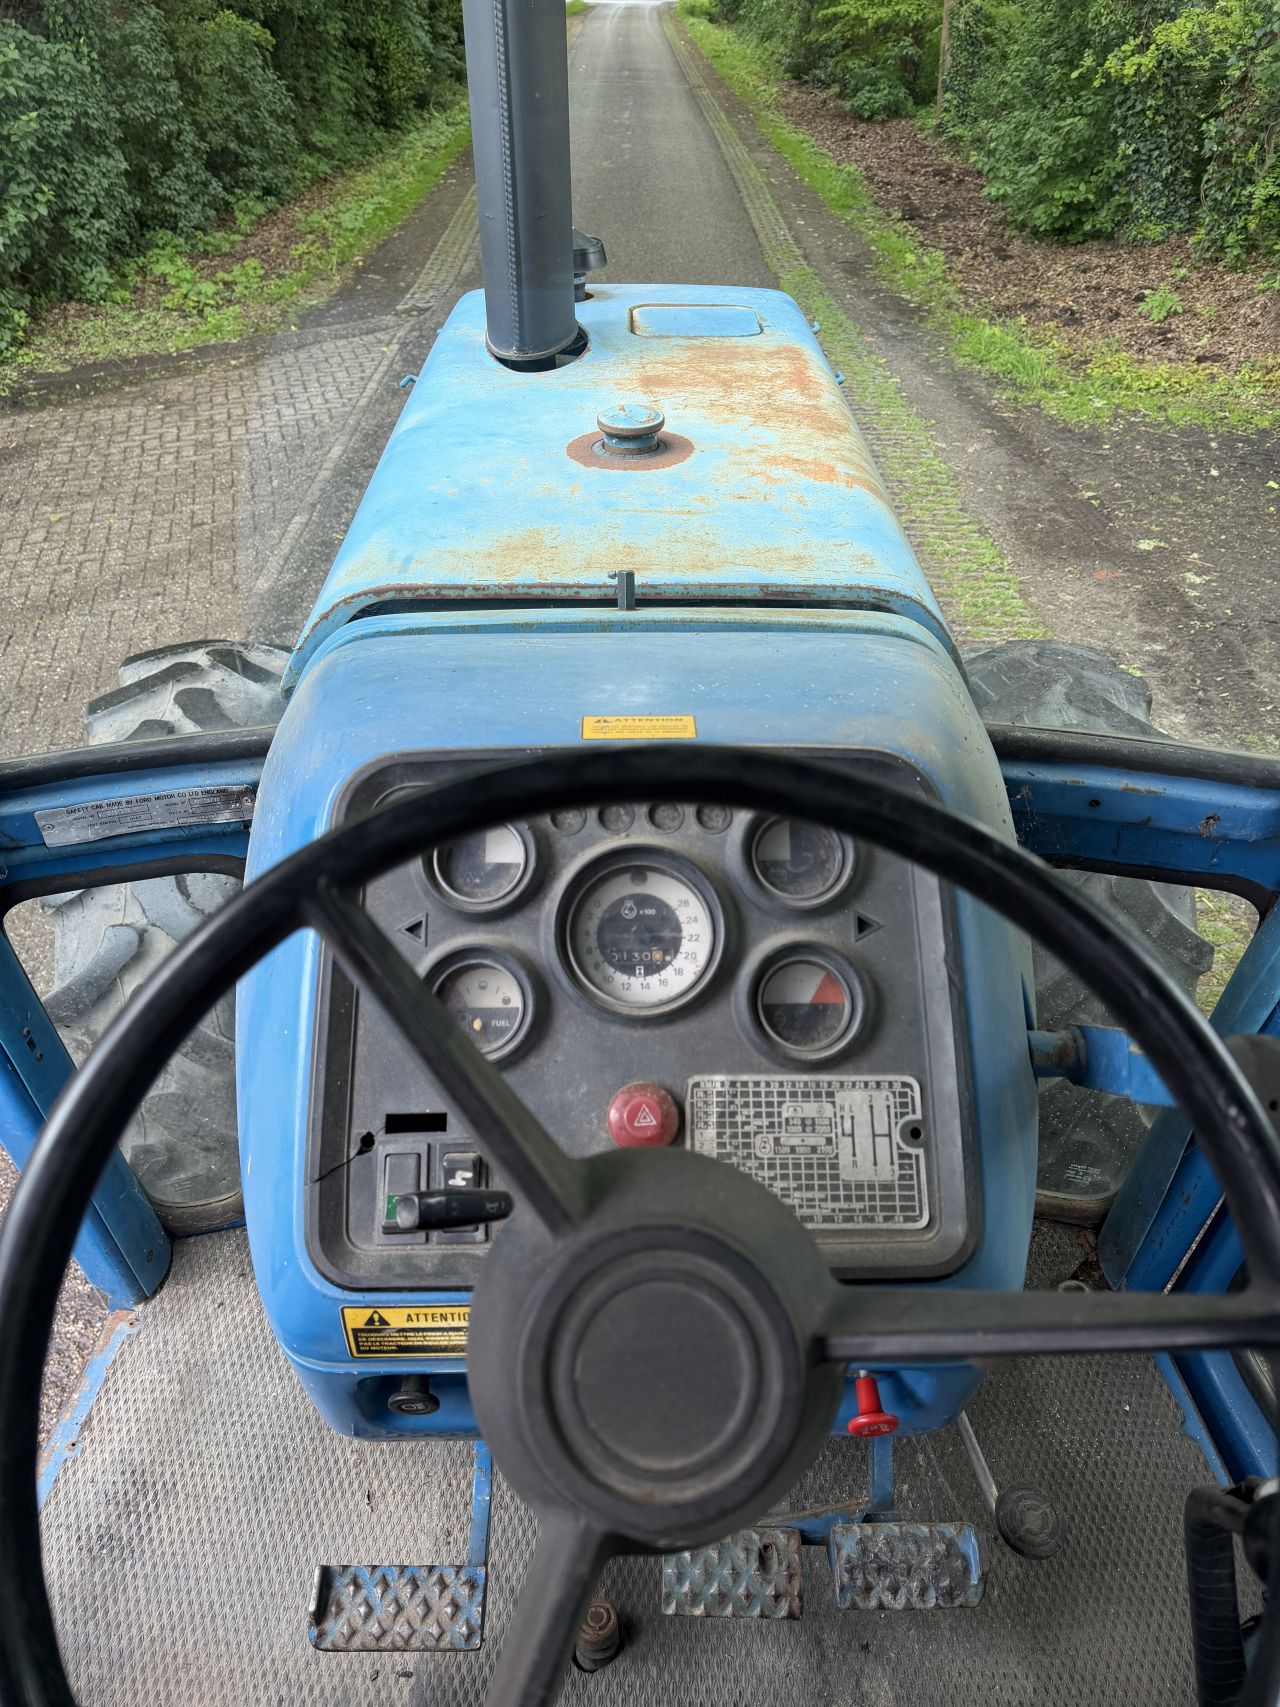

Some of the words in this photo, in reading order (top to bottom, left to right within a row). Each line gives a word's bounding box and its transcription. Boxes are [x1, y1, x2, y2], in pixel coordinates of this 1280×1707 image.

[65, 806, 89, 815] SAFETY
[91, 803, 104, 811] CAB
[106, 800, 123, 808] MADE
[154, 793, 175, 801] MOTOR
[201, 788, 229, 796] ENGLAND
[677, 899, 690, 908] 26
[686, 916, 699, 925] 24
[687, 934, 701, 943] 22
[684, 951, 697, 961] 20
[673, 967, 684, 977] 18
[603, 975, 614, 984] 10
[658, 978, 669, 988] 16
[621, 983, 632, 992] 12
[640, 983, 651, 992] 14
[491, 1019, 511, 1028] FUEL
[852, 1159, 858, 1169] R
[814, 1215, 823, 1224] 10
[835, 1215, 843, 1224] 12
[855, 1215, 863, 1224] 14
[875, 1215, 884, 1224] 16
[895, 1215, 904, 1224] 18
[406, 1311, 470, 1323] ATTENTIO
